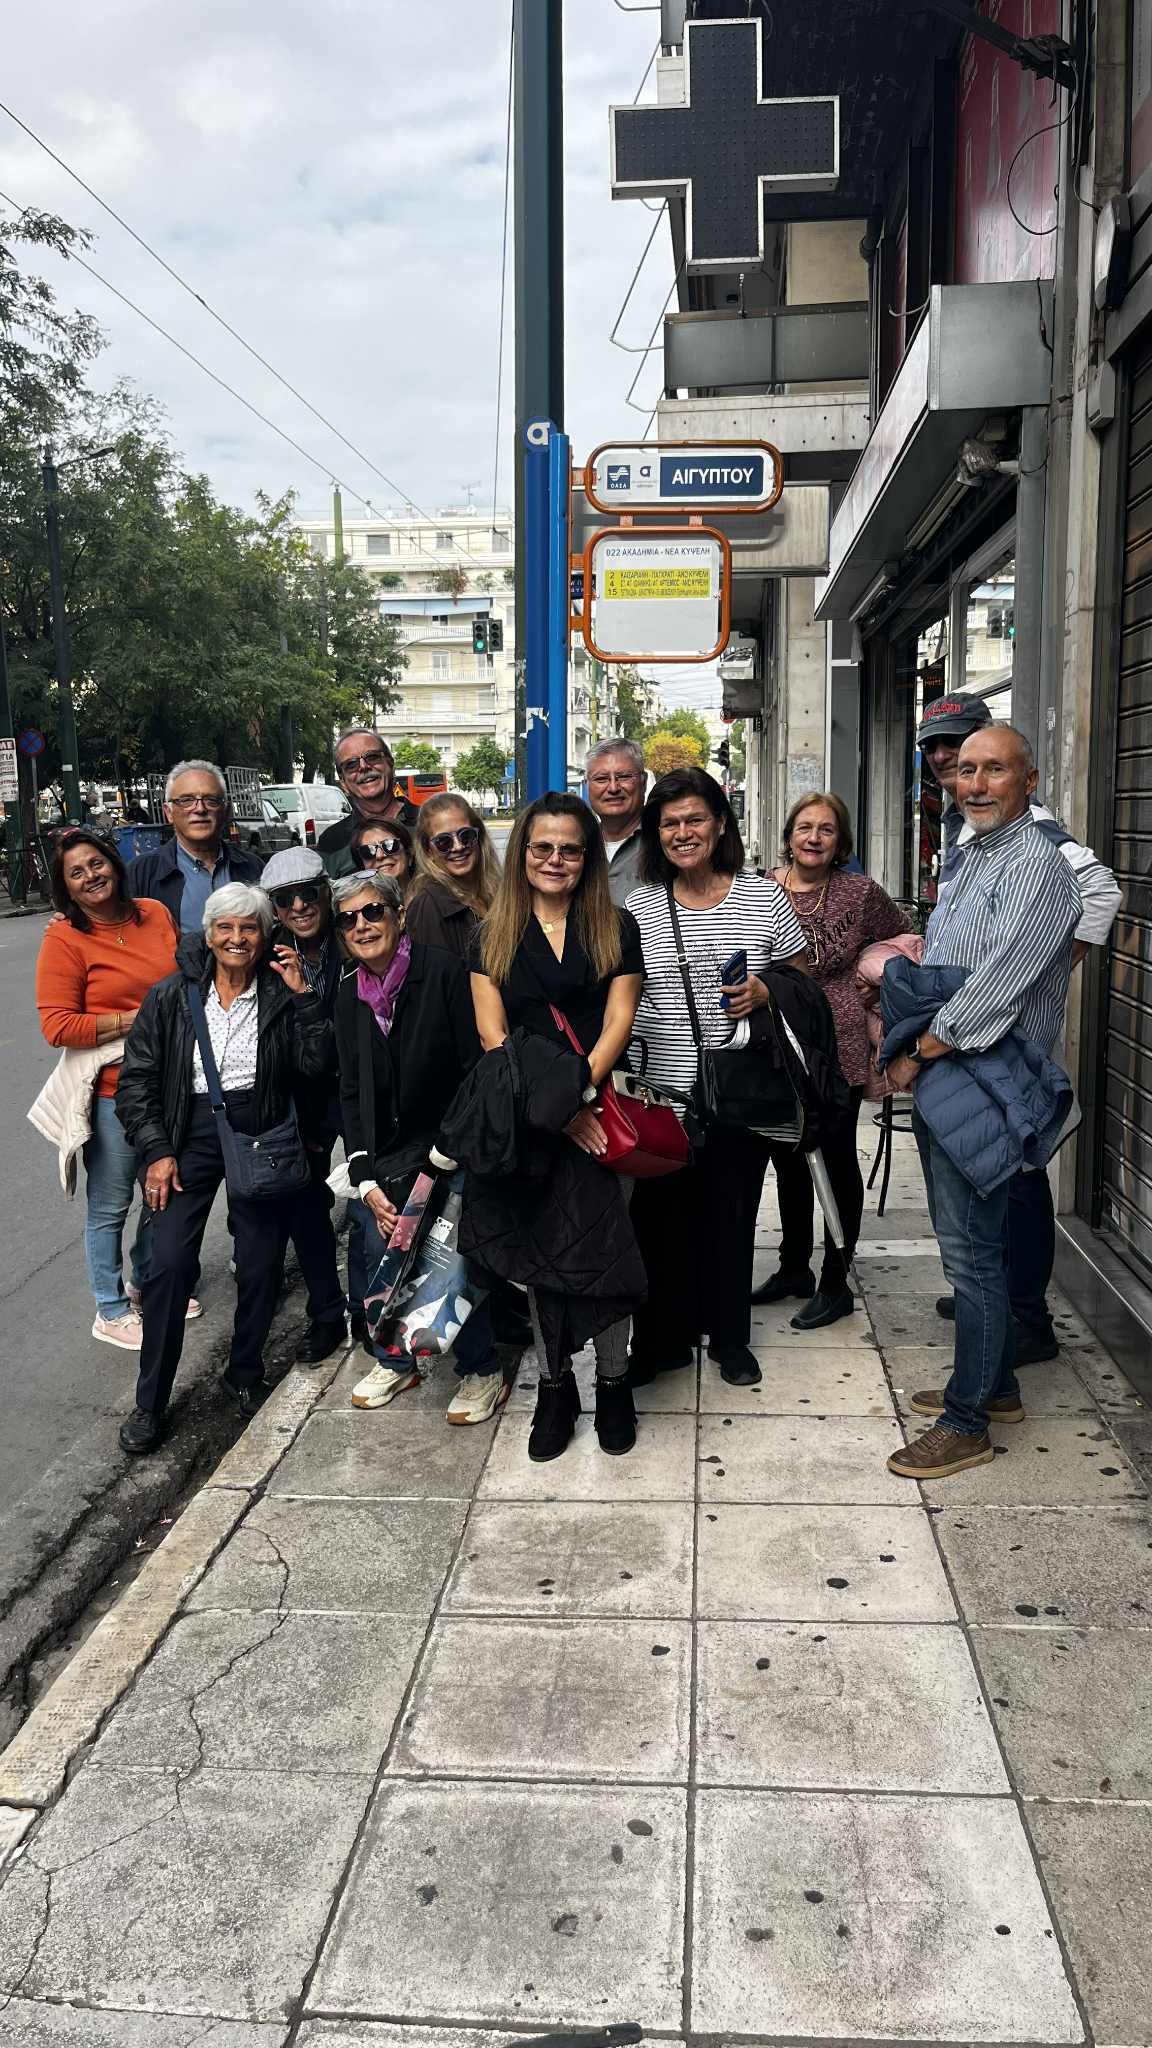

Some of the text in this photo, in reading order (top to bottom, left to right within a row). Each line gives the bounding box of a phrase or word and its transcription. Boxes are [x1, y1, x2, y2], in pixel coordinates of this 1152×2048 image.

[671, 467, 754, 485] ΑΙΓΥΠΤΟΥ
[606, 548, 621, 557] 022
[622, 548, 659, 556] ΑΚΑΔΗΜΙΑ
[665, 547, 679, 555] ΝΕΑ
[681, 547, 710, 555] ΚΥΨΕΛΗ
[609, 571, 615, 580] 2
[607, 588, 617, 596] 15
